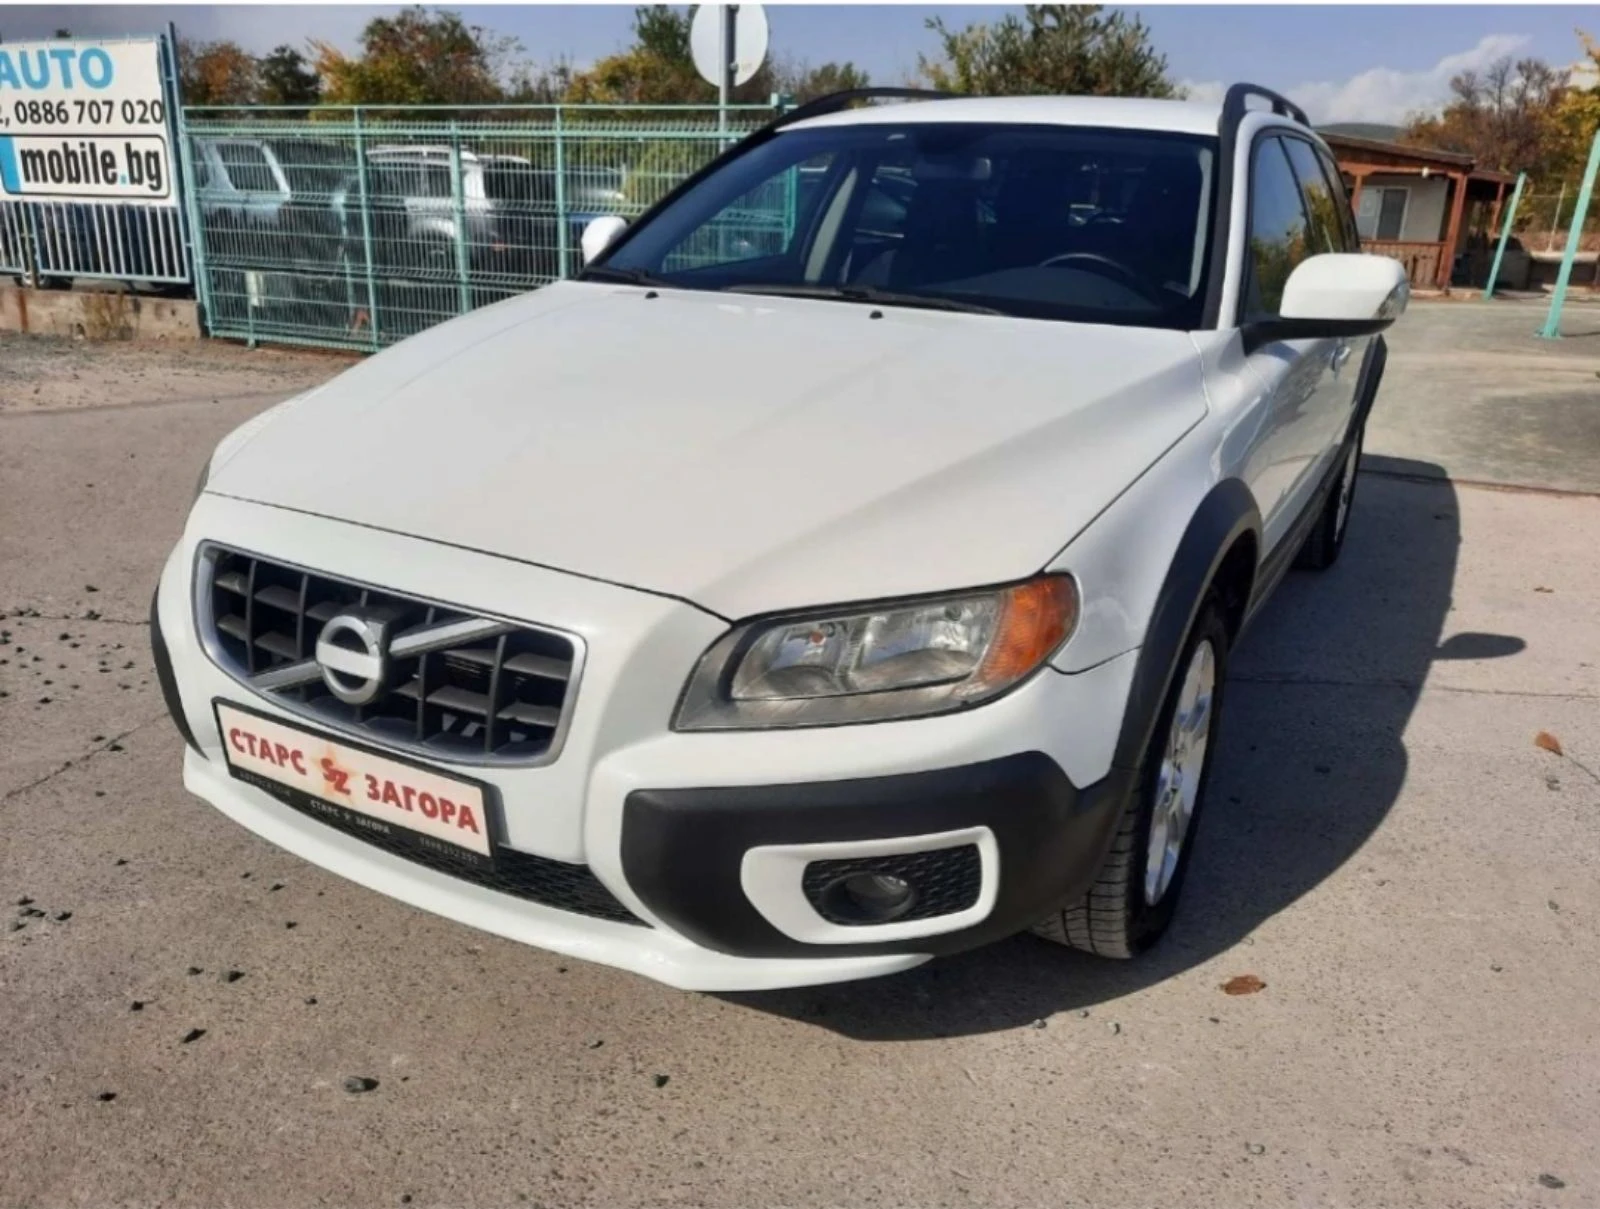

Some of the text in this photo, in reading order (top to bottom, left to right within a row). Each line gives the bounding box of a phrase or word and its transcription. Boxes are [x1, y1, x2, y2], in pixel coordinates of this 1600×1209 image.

[0, 48, 114, 90] AUTO
[14, 100, 70, 125] 0886
[74, 99, 114, 125] 707
[121, 99, 164, 125] 020
[20, 141, 163, 192] mobile.bg
[229, 727, 308, 775] СТАРС
[365, 773, 480, 835] ЗАГОРА
